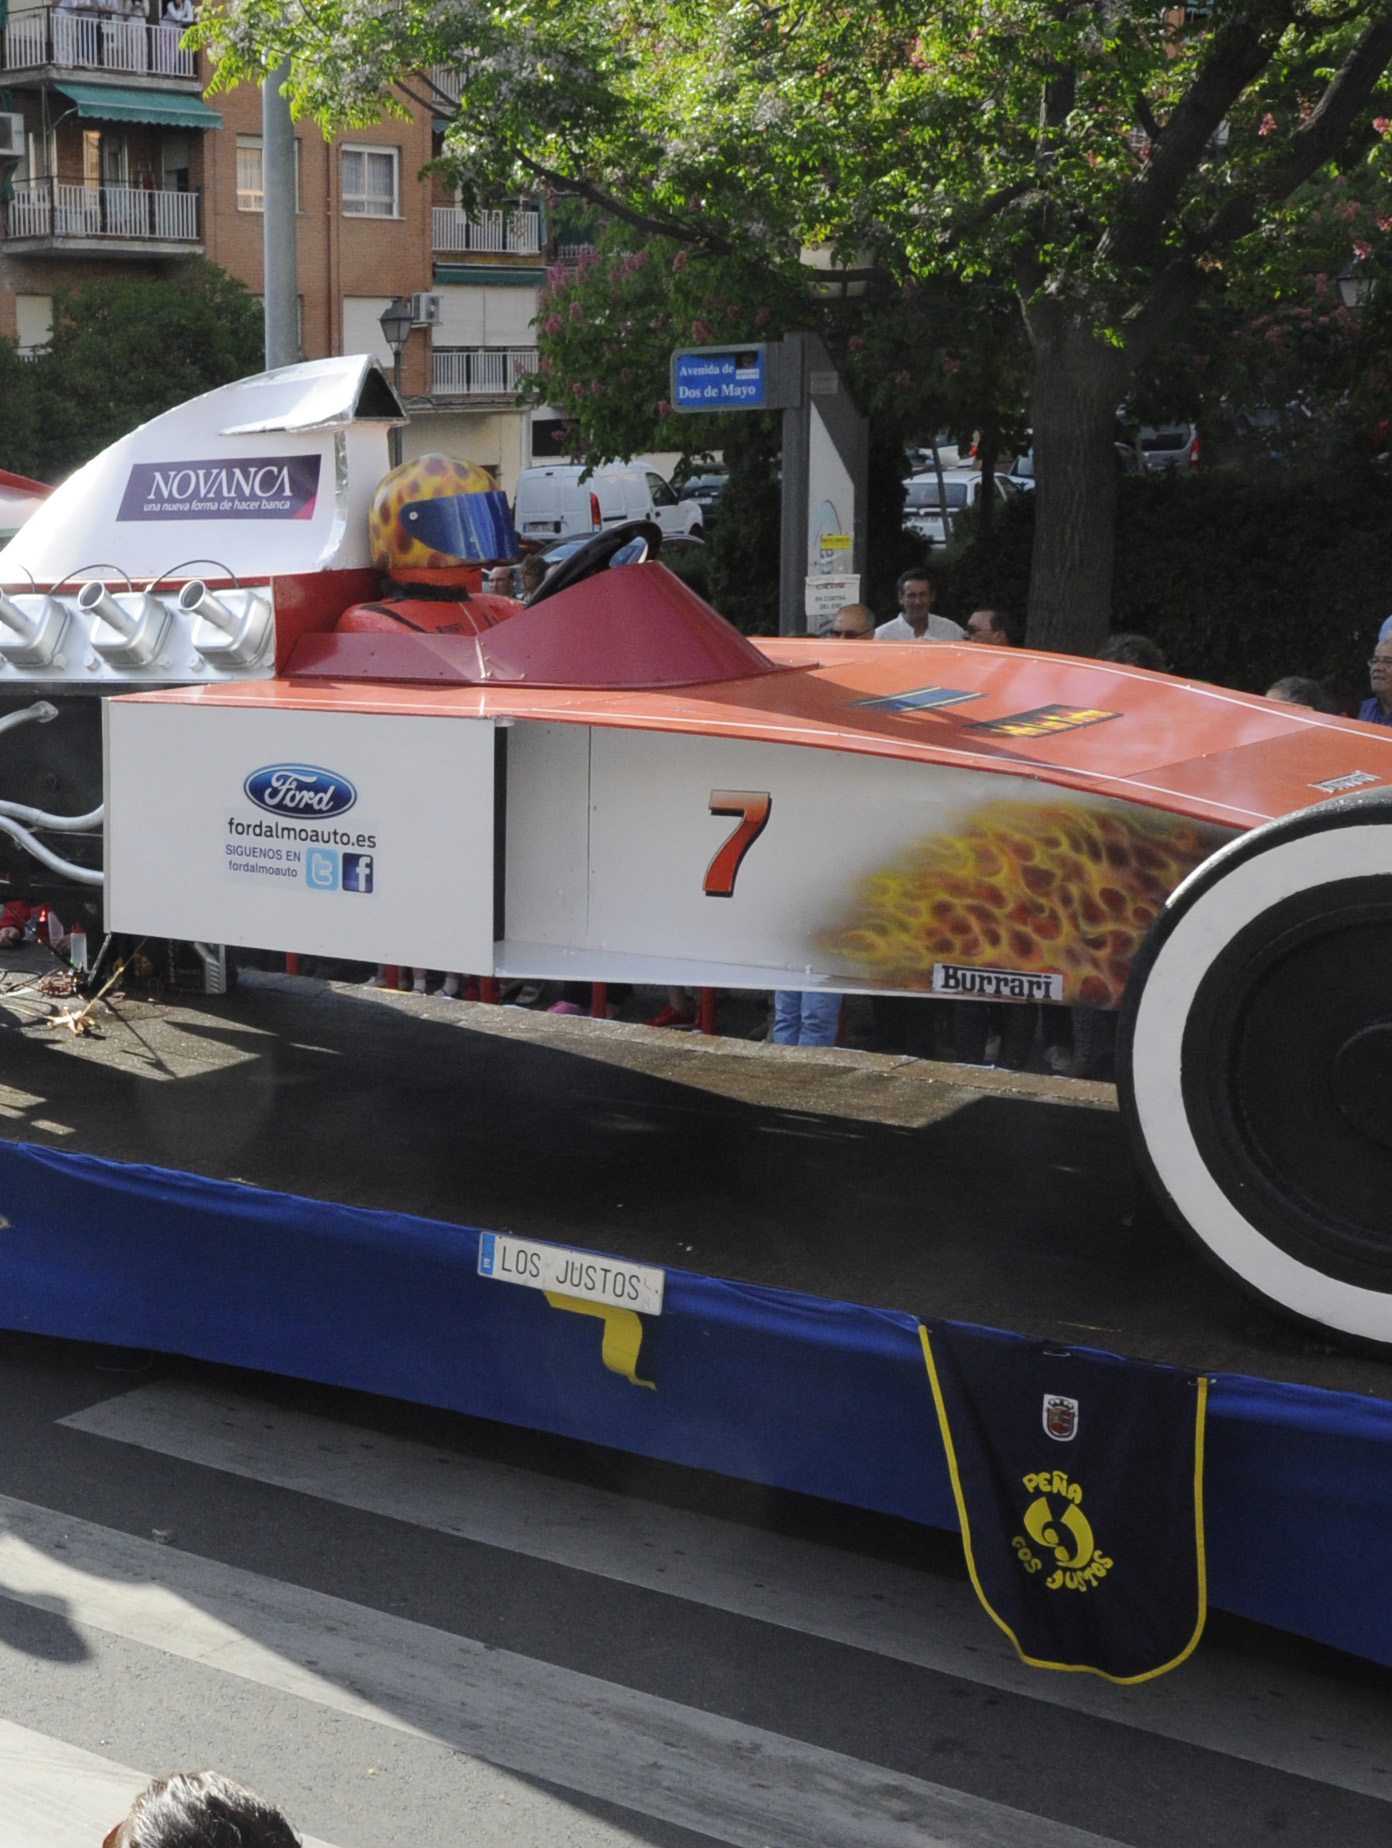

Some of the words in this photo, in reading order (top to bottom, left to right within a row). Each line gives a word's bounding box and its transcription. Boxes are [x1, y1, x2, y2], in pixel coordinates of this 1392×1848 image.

[679, 364, 720, 377] Avenida
[722, 363, 735, 374] de
[679, 385, 701, 399] Dos
[703, 384, 719, 397] de
[721, 383, 757, 399] Mayo
[146, 466, 293, 500] NOVANCA
[143, 503, 161, 512] una
[162, 502, 190, 512] nueva
[191, 499, 219, 512] forma
[219, 499, 232, 511] de
[233, 499, 260, 510] hacer
[261, 499, 291, 510] banca
[263, 770, 336, 811] Ford
[227, 817, 377, 849] fordalmoauto.es
[702, 788, 773, 898] 7
[225, 844, 283, 861] SIGUENOS
[285, 850, 301, 862] EN
[228, 859, 298, 878] fordalmoauto
[940, 964, 1053, 1000] Burrari
[501, 1245, 542, 1279] LOS
[555, 1259, 641, 1301] JUSTOS
[1022, 1470, 1083, 1505] PEÑA
[1045, 1549, 1114, 1592] JUSTOS
